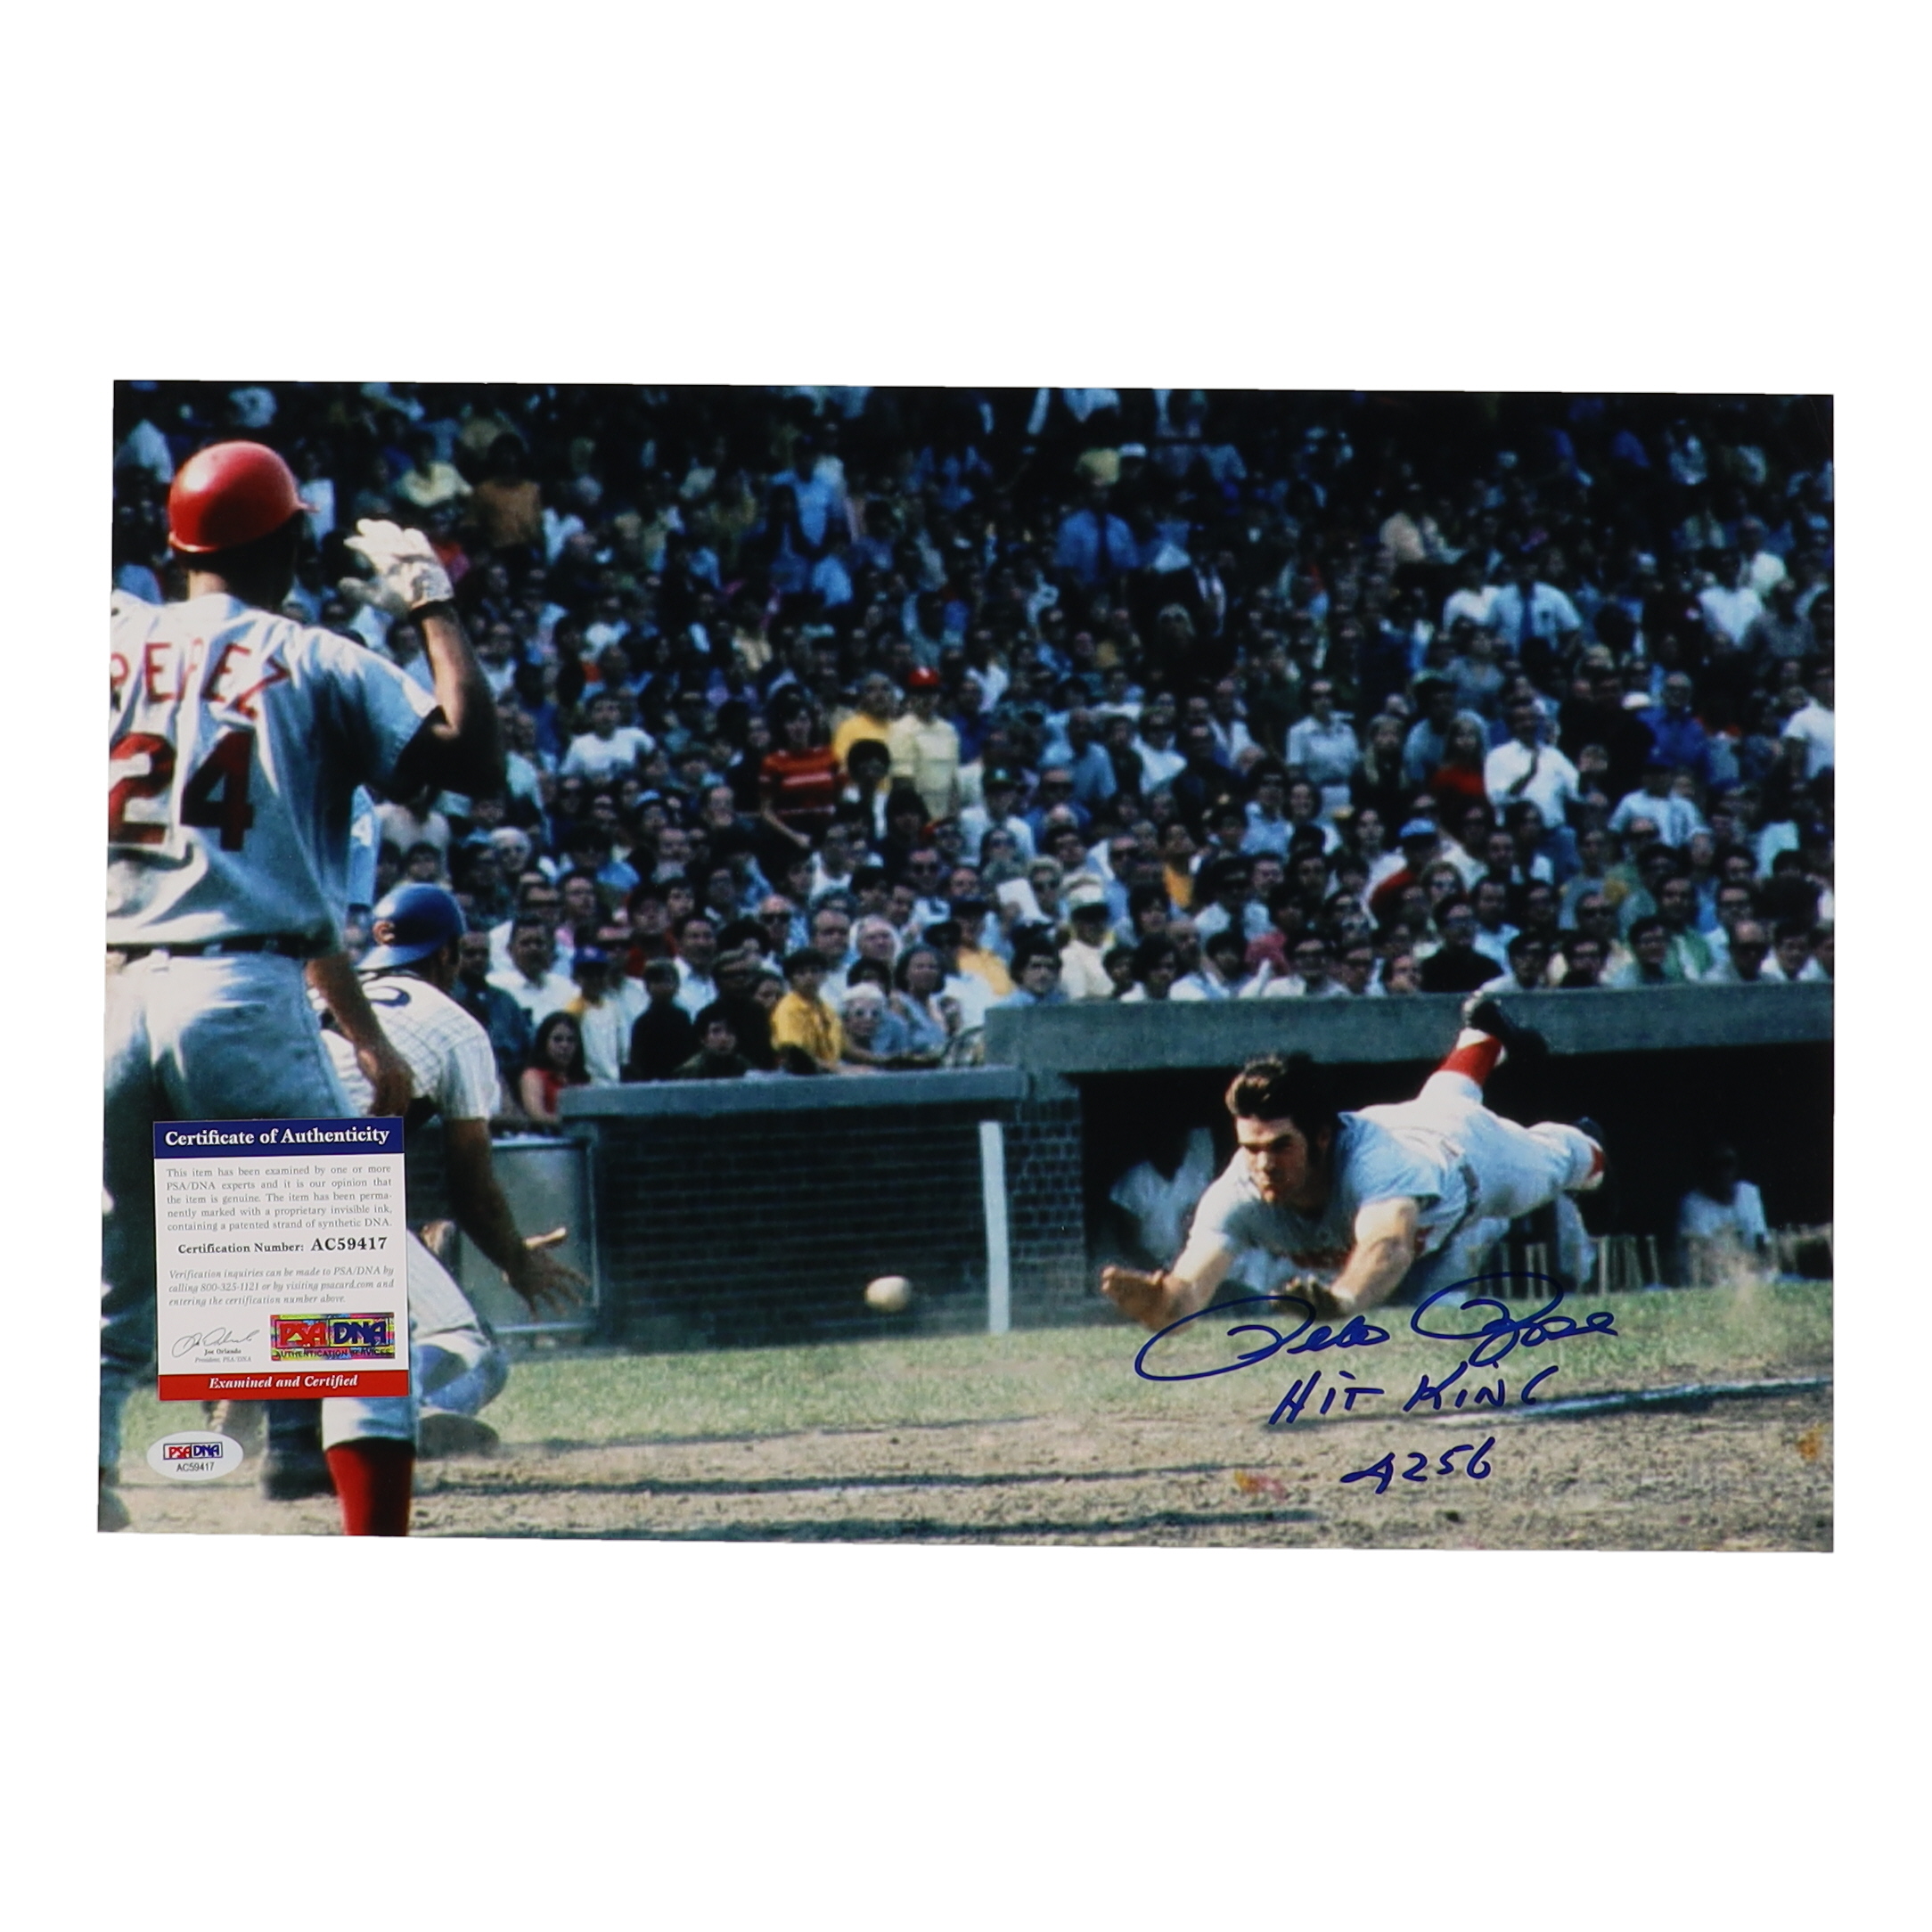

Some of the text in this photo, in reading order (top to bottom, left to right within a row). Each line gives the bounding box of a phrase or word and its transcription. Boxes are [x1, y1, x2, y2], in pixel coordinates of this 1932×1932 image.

[108, 732, 257, 851] 24
[165, 1127, 389, 1146] Certificate of Authenticity
[167, 1169, 187, 1177] This
[192, 1168, 212, 1176] item
[217, 1167, 233, 1176] has
[238, 1167, 260, 1175] been
[265, 1167, 309, 1175] examined
[315, 1167, 324, 1175] by
[167, 1182, 216, 1191] PSA/DNA
[222, 1182, 255, 1191] experts
[261, 1181, 277, 1189] and
[284, 1180, 291, 1188] it
[296, 1180, 304, 1188] is
[332, 1179, 367, 1188] opinion
[373, 1178, 391, 1186] that
[167, 1192, 392, 1204] the item is genuine. The item has been perma-
[168, 1209, 196, 1218] nently
[201, 1208, 235, 1216] marked
[240, 1208, 260, 1216] with
[274, 1207, 326, 1216] proprietary
[331, 1206, 370, 1214] invisible
[374, 1205, 392, 1214] ink,
[168, 1222, 217, 1232] containing
[229, 1221, 269, 1231] patented
[273, 1220, 302, 1228] strand
[306, 1219, 315, 1228] of
[318, 1218, 361, 1229] synthetic
[364, 1218, 391, 1227] DNA.
[178, 1237, 388, 1254] Certification Number: AC59417
[169, 1269, 221, 1280] Verification
[224, 1268, 263, 1280] inquiries
[283, 1267, 294, 1276] be
[296, 1267, 320, 1275] made
[333, 1266, 381, 1275] PSA/DNA
[383, 1266, 394, 1276] by
[168, 1283, 198, 1293] calling
[201, 1282, 259, 1291] 800-325-1121
[273, 1281, 284, 1291] by
[286, 1281, 318, 1290] visiting
[321, 1280, 373, 1290] psacard.com
[376, 1280, 394, 1288] and
[169, 1295, 345, 1307] entering the certification number above.
[279, 1322, 327, 1347] PSA
[333, 1321, 387, 1347] DNA
[209, 1374, 357, 1389] Examined and Certified
[168, 1445, 219, 1459] PSA DNA
[176, 1462, 215, 1472] AC59417
[1339, 1436, 1496, 1494] 4256
